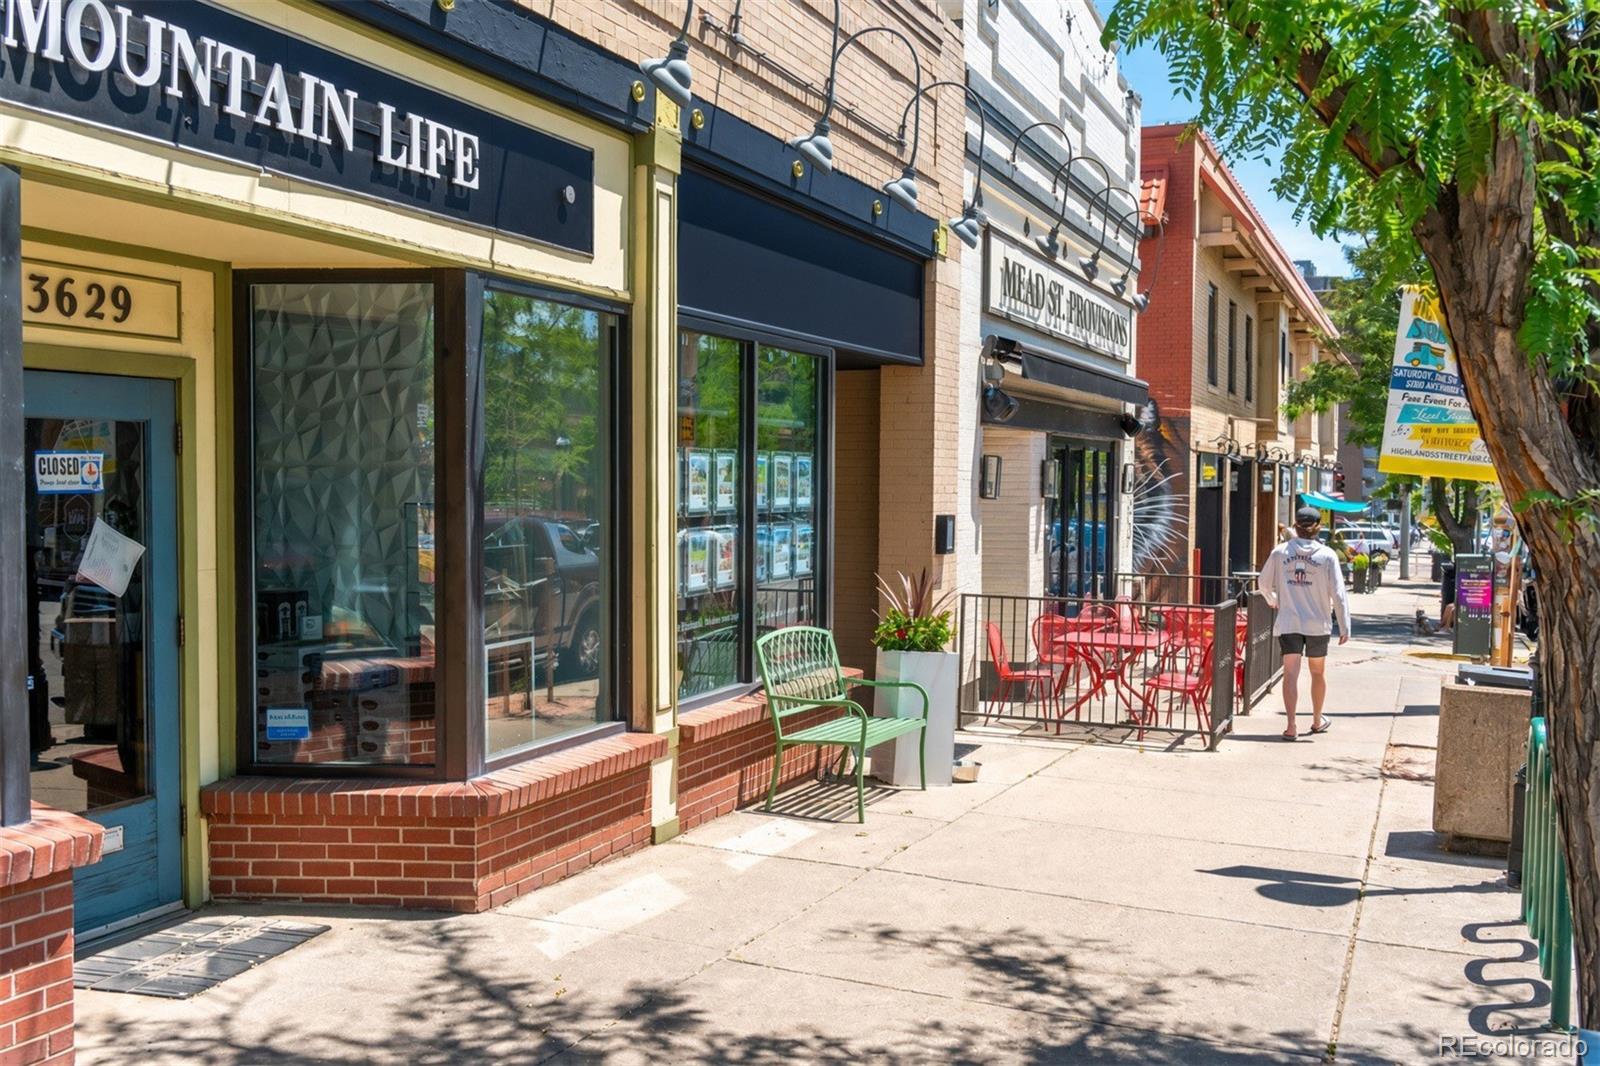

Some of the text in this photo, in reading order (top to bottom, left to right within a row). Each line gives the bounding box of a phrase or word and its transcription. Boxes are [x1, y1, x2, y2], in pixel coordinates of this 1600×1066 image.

[3, 0, 480, 191] MOUNTAIN LIFE
[27, 272, 132, 323] 3629
[1002, 257, 1129, 348] MEAD ST. PROVISIONS
[1401, 392, 1422, 403] Free
[1423, 395, 1447, 406] Event
[1448, 398, 1462, 408] For
[38, 456, 80, 476] CLOSED
[1391, 447, 1493, 464] HIGHLANDSSTREETFAIR.CO
